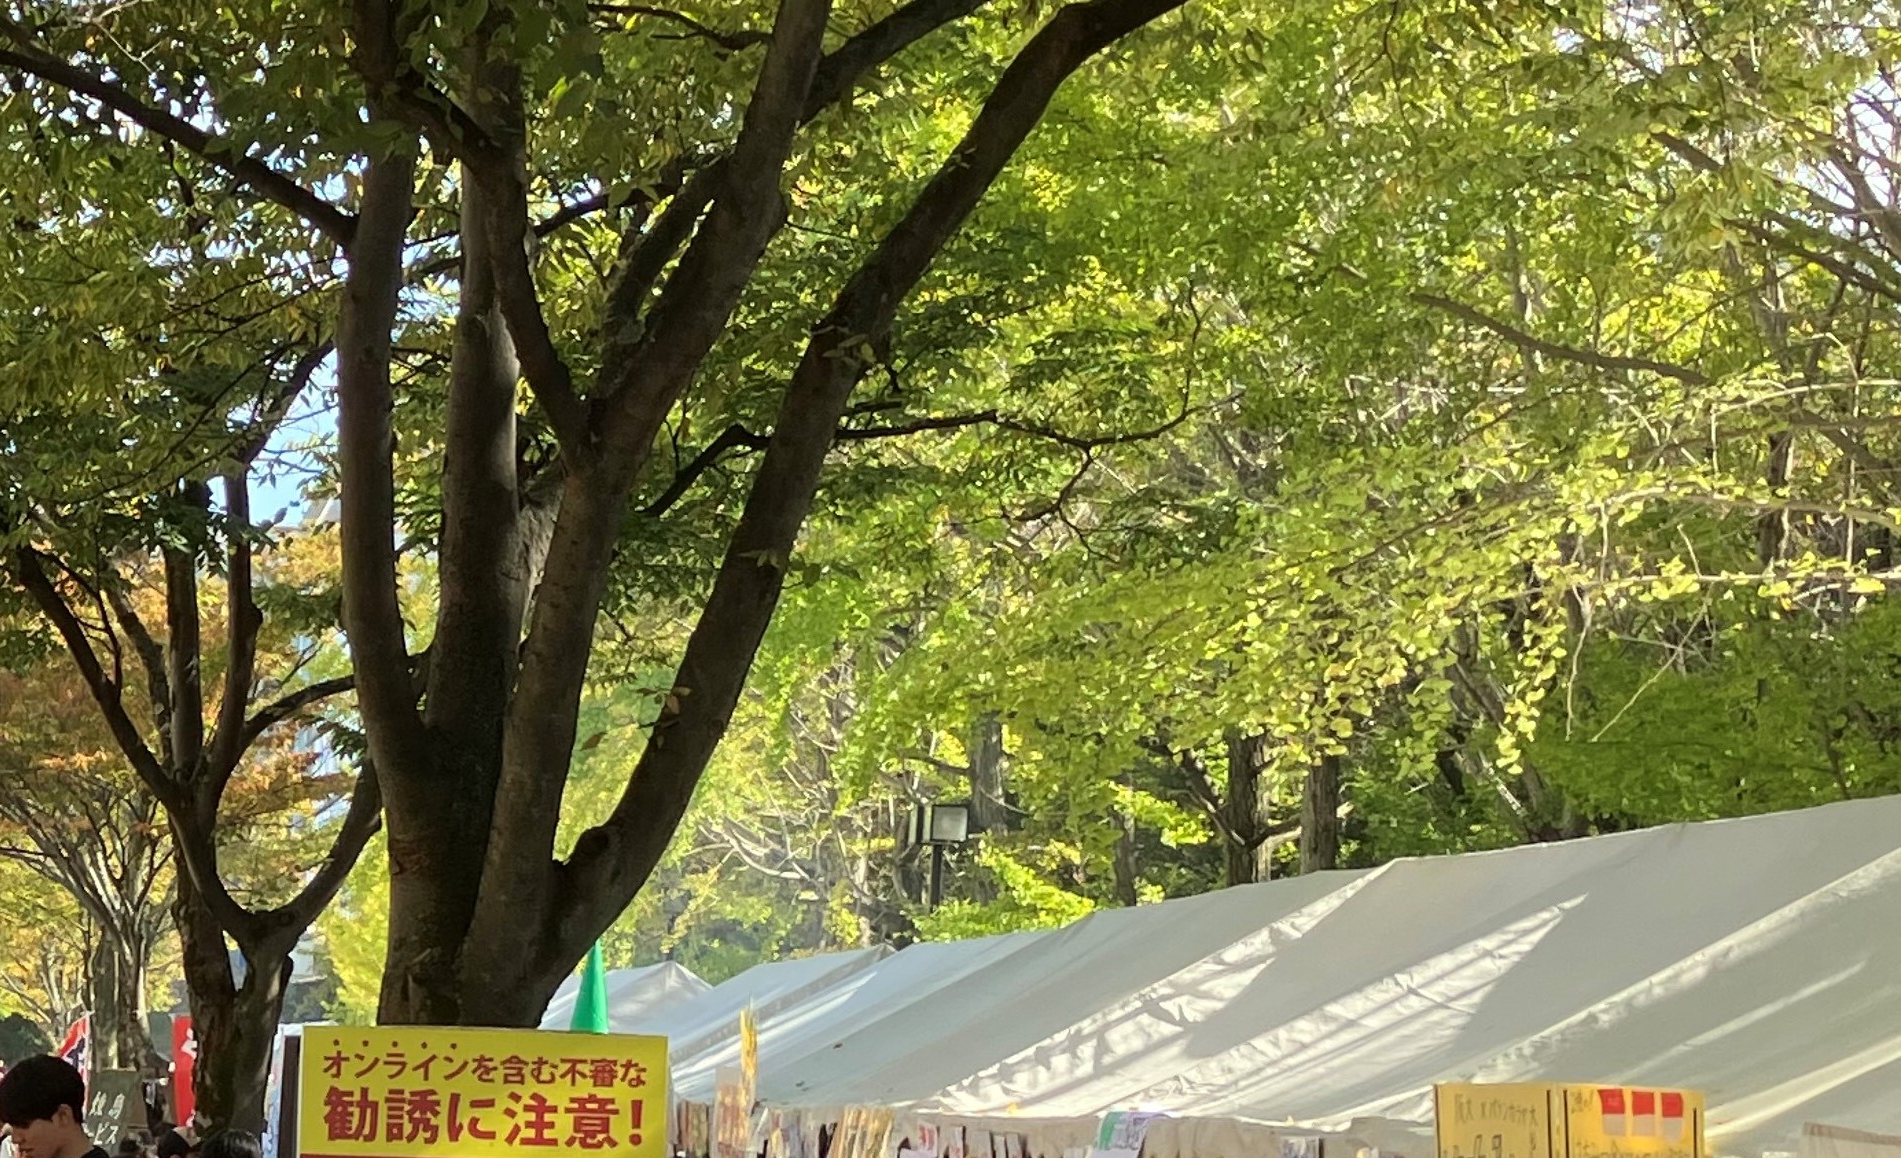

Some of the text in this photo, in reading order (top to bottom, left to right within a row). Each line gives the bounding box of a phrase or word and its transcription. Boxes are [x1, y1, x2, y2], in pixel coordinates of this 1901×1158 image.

[323, 1050, 648, 1088] オンラインを含む不審な
[324, 1086, 644, 1150] 勧誘に注意！
